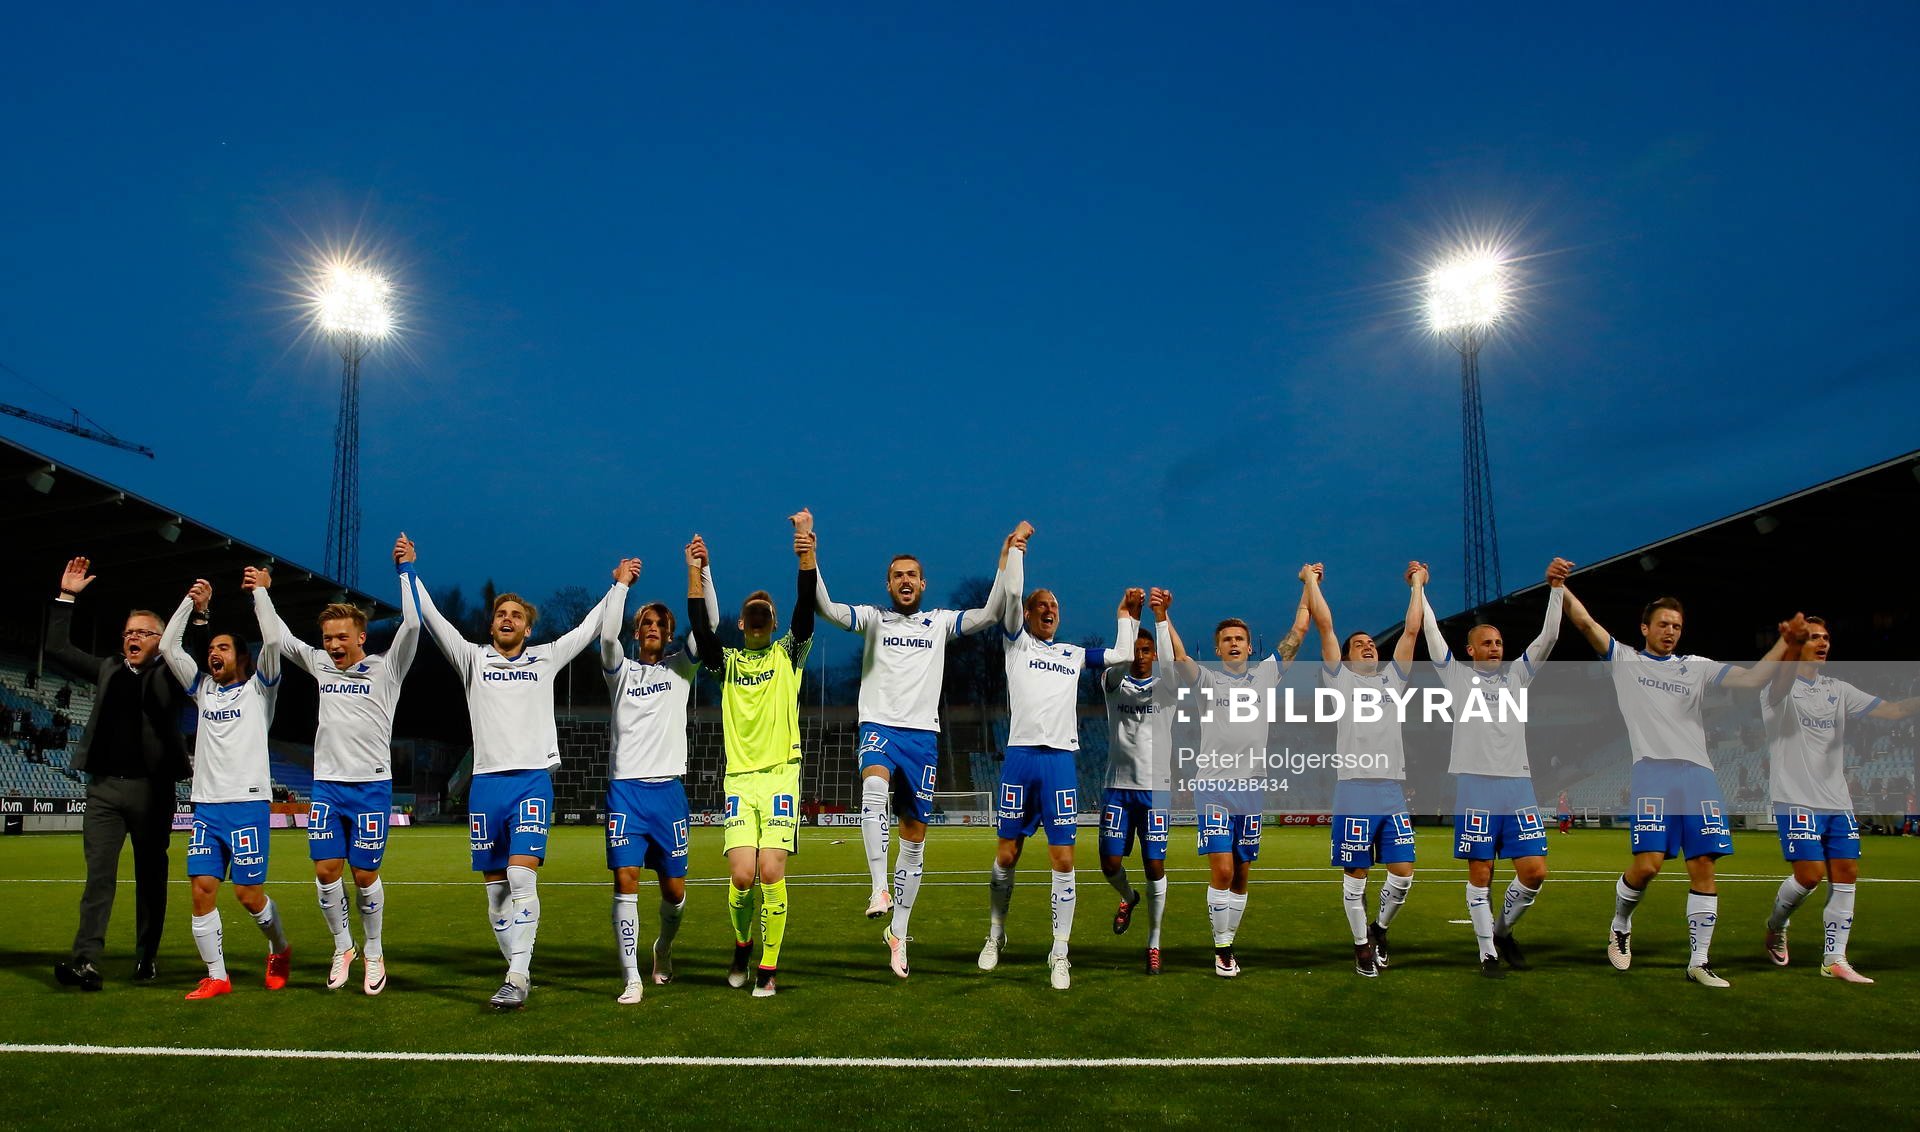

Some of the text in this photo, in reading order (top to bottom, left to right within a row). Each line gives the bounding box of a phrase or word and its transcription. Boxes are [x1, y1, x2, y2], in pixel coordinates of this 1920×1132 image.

[883, 637, 933, 649] HOLMEN
[1029, 660, 1075, 676] HOLMEN
[483, 671, 538, 682] HOLMEN
[736, 670, 775, 687] HOLMEN
[320, 684, 370, 695] HOLMEN
[626, 681, 672, 697] HOLMEN
[1637, 676, 1690, 696] HOLMEN
[1117, 703, 1161, 714] HOLMEN
[1, 799, 23, 812] kvm
[33, 800, 53, 813] kvm
[177, 801, 191, 813] kvm
[515, 825, 547, 836] stadium
[1787, 831, 1821, 841] stadium
[1460, 832, 1492, 843] stadium
[1634, 834, 1639, 845] 3
[1459, 842, 1471, 852] 20
[1789, 842, 1795, 853] 6
[1341, 851, 1352, 862] 30
[894, 869, 907, 905] suez
[621, 919, 636, 956] suez
[1824, 922, 1837, 952] suez
